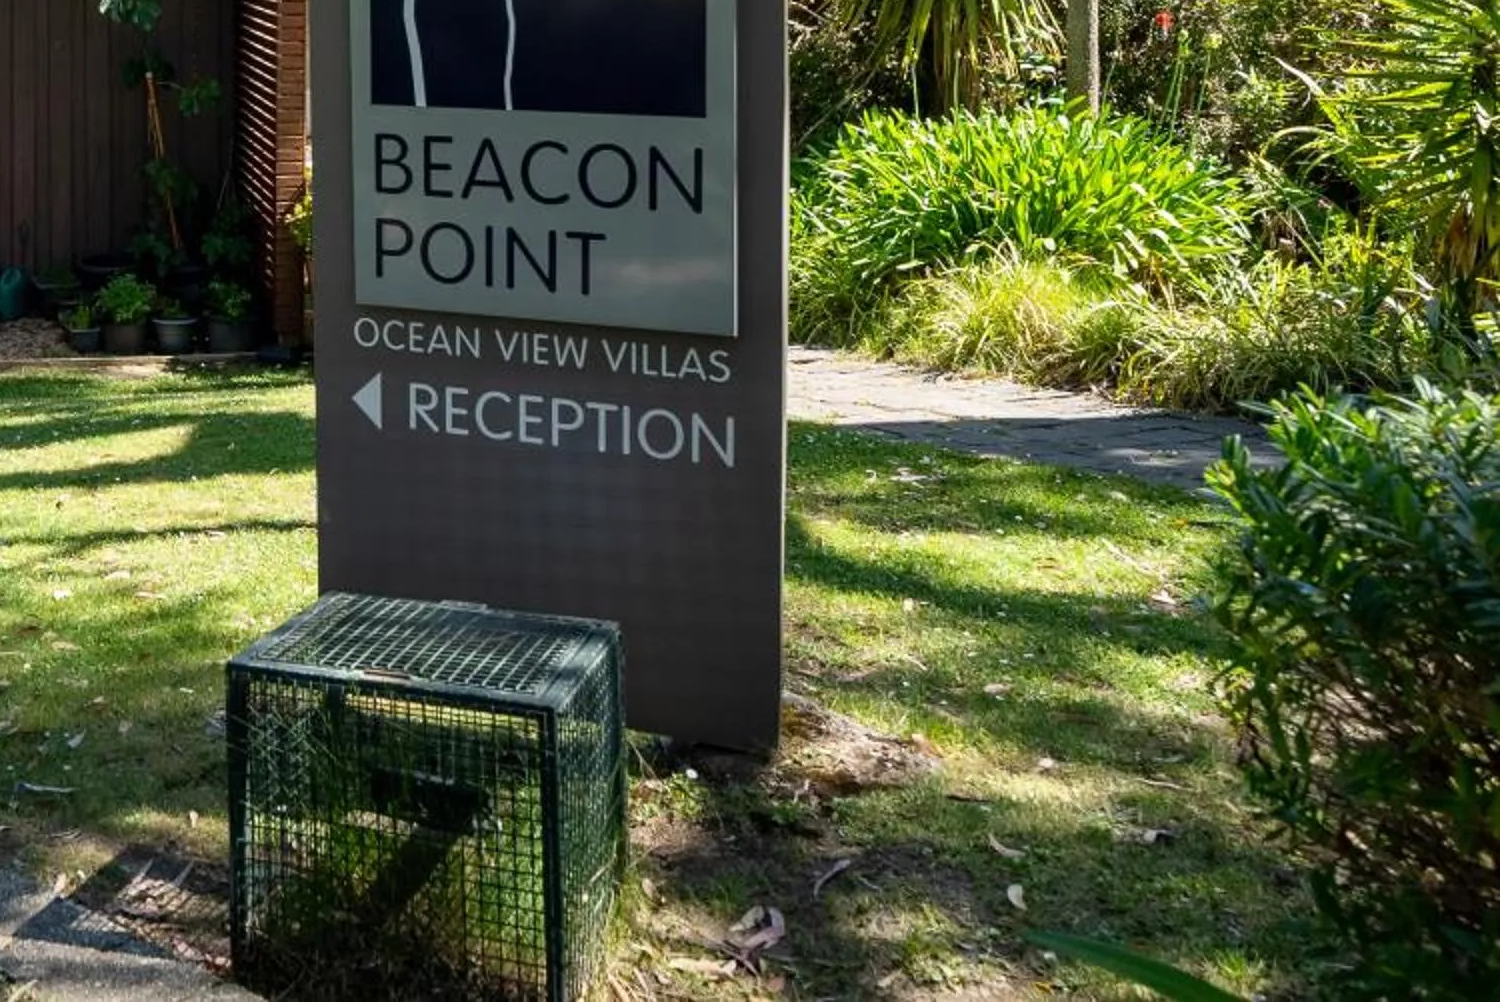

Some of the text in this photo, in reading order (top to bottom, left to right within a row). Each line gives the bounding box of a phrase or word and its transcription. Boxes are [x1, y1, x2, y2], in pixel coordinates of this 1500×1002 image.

[374, 133, 703, 214] BEACON
[375, 217, 606, 295] POINT
[353, 317, 731, 383] OCEAN VIEW VILLAS
[409, 382, 735, 468] RECEPTION
